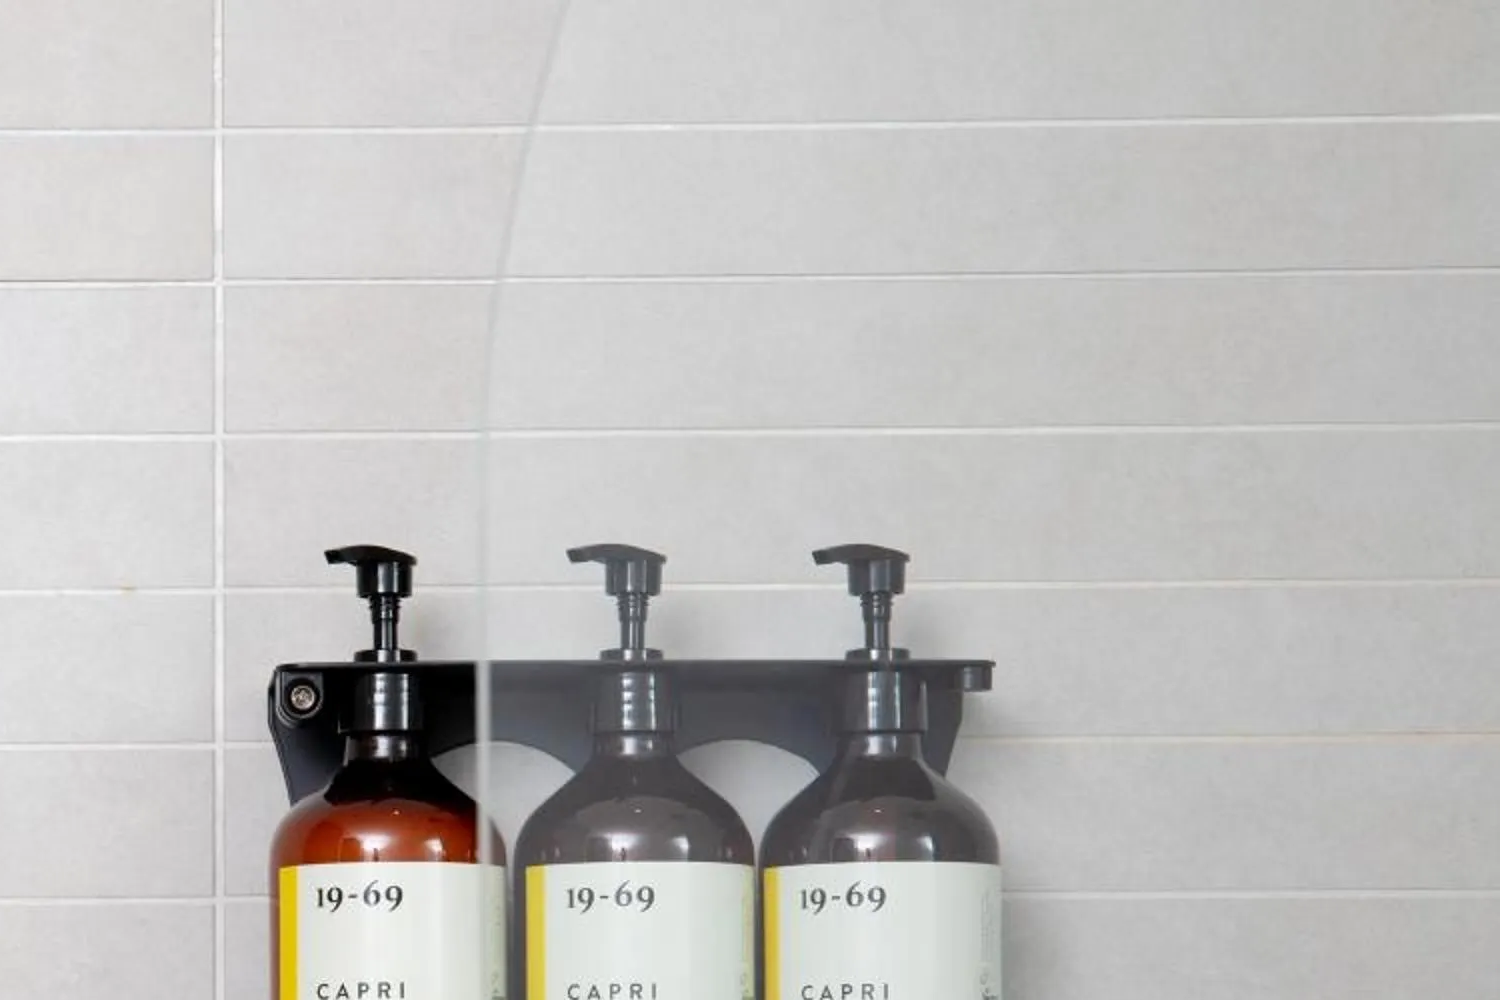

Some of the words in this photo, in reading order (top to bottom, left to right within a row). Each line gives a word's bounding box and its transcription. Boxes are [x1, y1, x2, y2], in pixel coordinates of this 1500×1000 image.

[316, 879, 404, 913] 19-69
[566, 879, 656, 914] 19-69
[801, 880, 887, 915] 19-69
[316, 982, 405, 1000] CAPRI
[567, 982, 657, 1000] CAPRI
